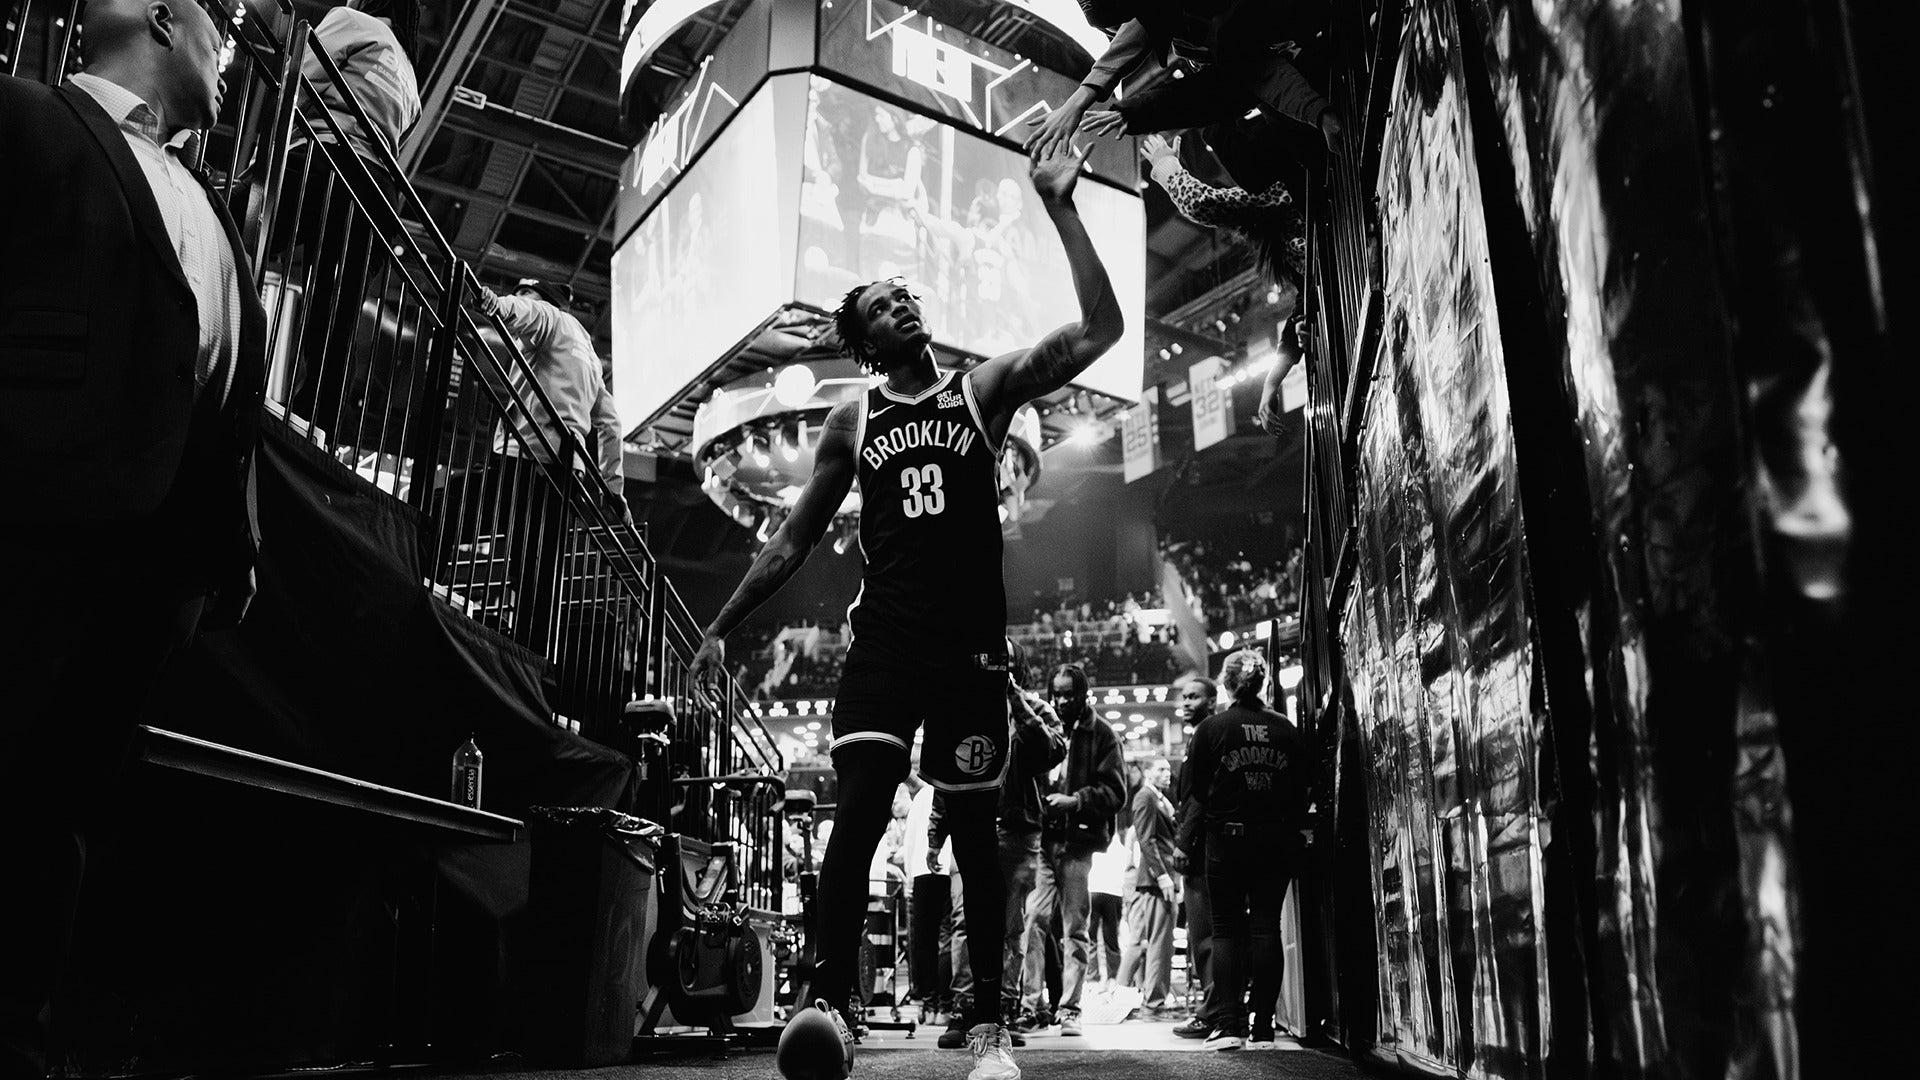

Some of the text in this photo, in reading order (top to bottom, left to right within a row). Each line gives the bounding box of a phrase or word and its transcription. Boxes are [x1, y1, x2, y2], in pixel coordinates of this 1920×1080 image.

[938, 394, 962, 403] YOUR
[938, 400, 965, 409] GUIDE
[862, 420, 976, 470] BROOKLYN
[901, 463, 945, 518] 33
[1241, 724, 1270, 742] THE
[1244, 771, 1273, 790] WAY
